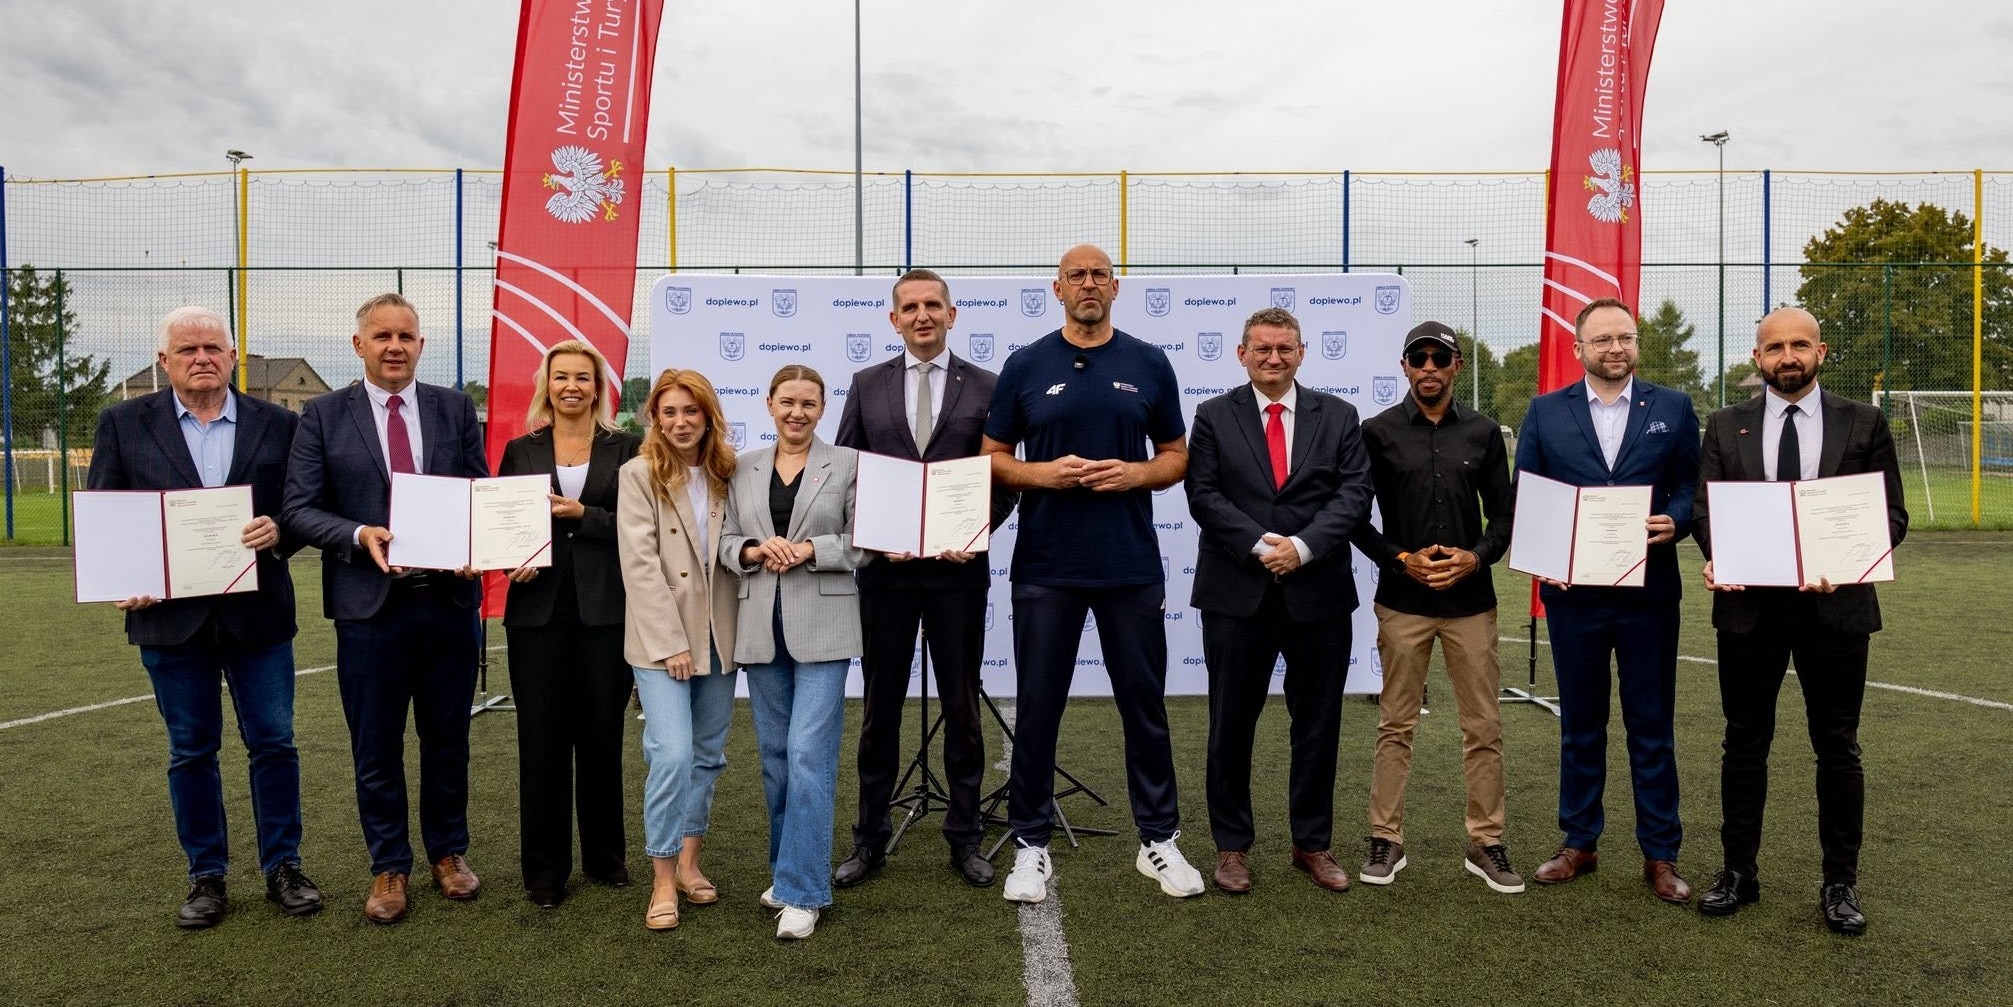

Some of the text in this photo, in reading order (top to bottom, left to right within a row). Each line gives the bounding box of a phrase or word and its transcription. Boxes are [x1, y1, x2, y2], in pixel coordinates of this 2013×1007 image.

[587, 0, 627, 141] Sportu i Tur
[705, 297, 759, 308] dopiewo.pl
[832, 298, 885, 308] dopiewo.pl
[955, 298, 1008, 308] dopiewo.pl
[1184, 297, 1236, 308] dopiewo.pl
[1309, 296, 1362, 306] dopiewo.pl
[758, 342, 811, 353] dopiewo.pl
[714, 386, 759, 397] opiewo.pl
